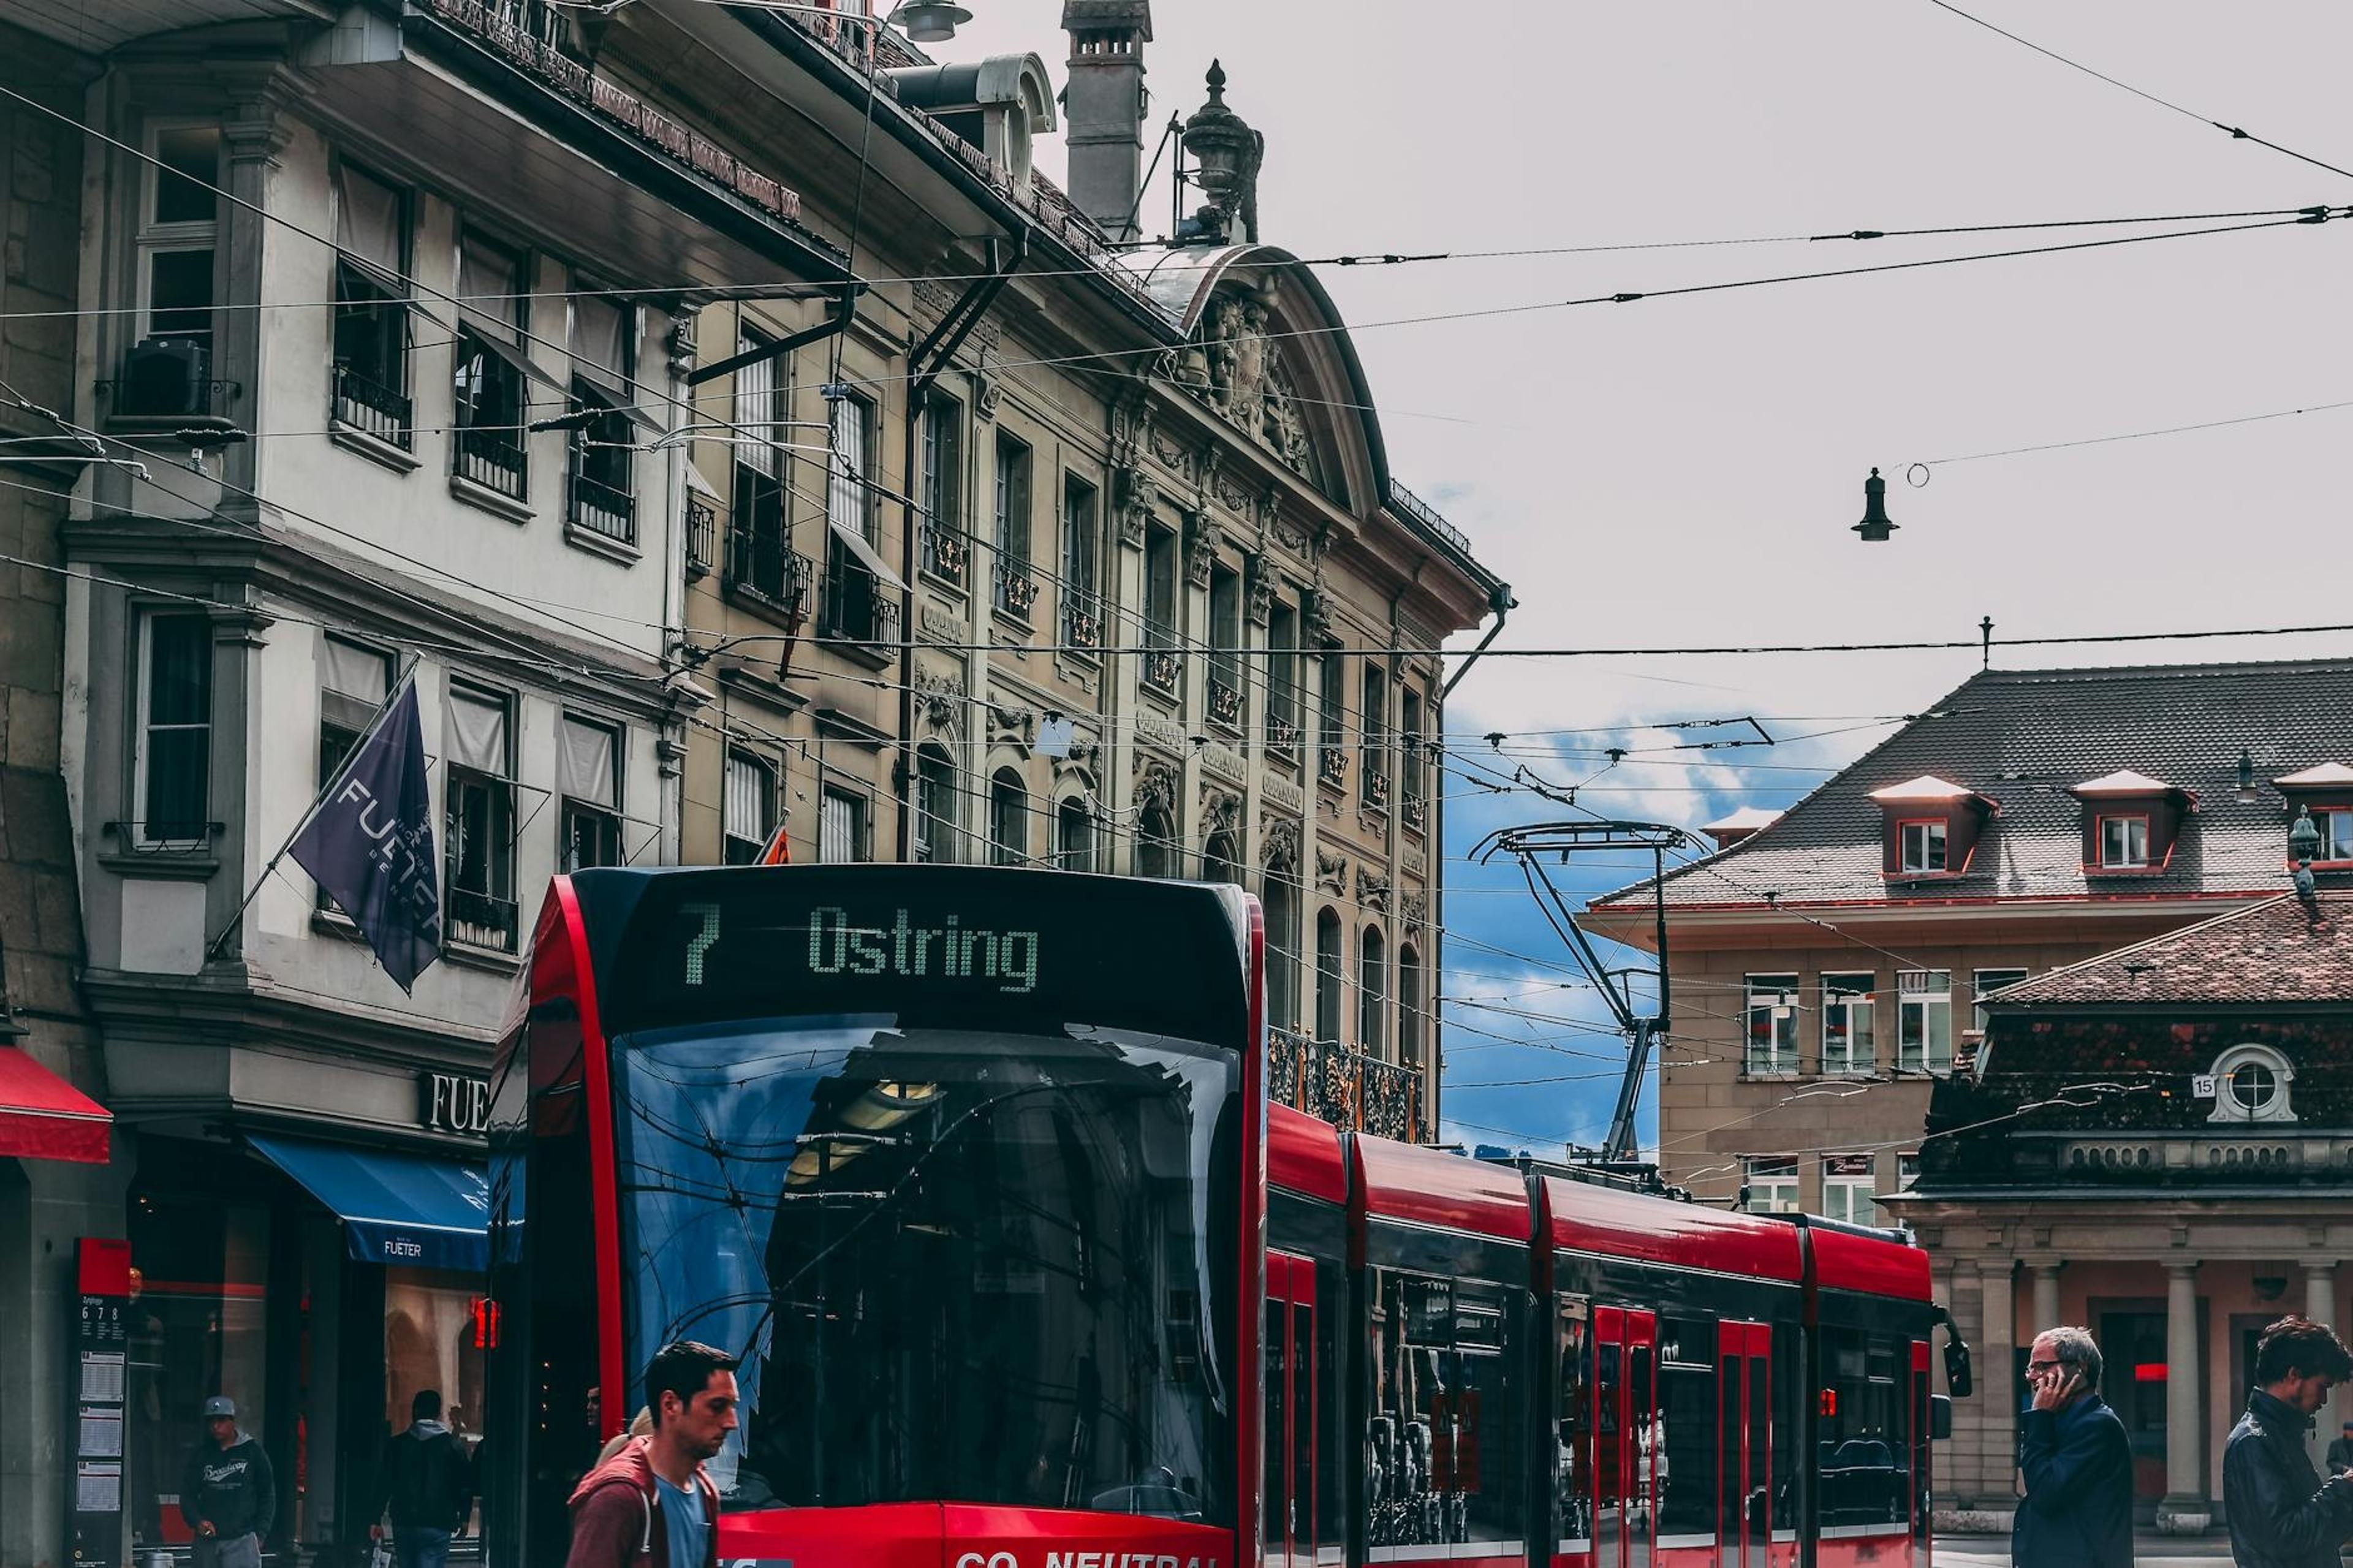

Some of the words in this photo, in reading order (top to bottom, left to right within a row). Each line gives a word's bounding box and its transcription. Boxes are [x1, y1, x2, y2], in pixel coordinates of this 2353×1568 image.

[679, 904, 719, 983] 7
[809, 906, 1038, 993] Ostring
[2195, 1080, 2212, 1093] 15
[385, 1241, 421, 1257] FUETER
[82, 1307, 88, 1319] 6
[98, 1307, 104, 1320] 7
[112, 1308, 118, 1320] 8
